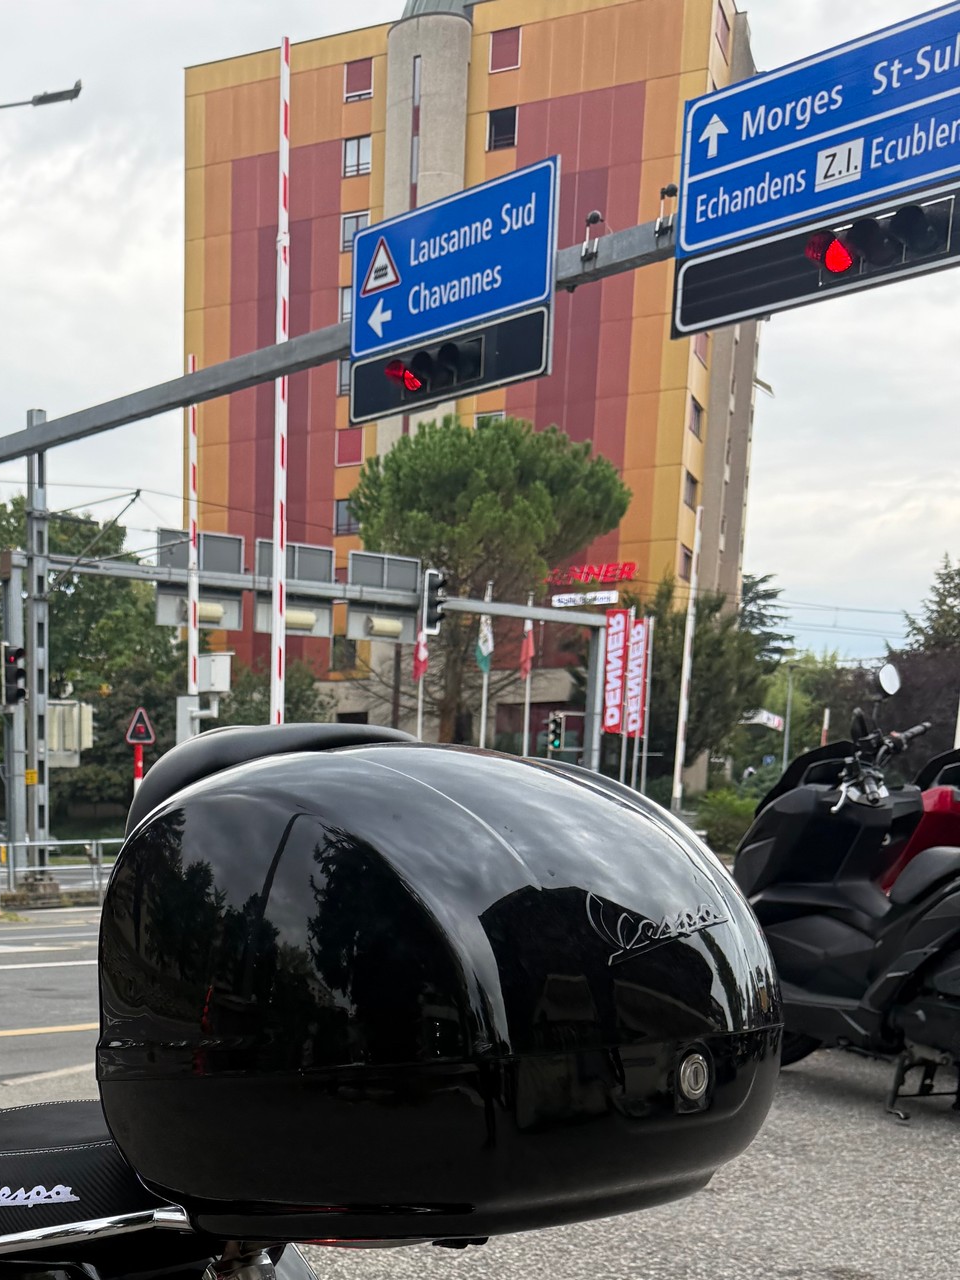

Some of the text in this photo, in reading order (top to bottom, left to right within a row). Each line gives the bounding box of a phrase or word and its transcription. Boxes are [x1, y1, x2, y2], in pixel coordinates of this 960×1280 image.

[741, 32, 960, 141] Morges St-Sul
[696, 168, 806, 224] Echandens
[823, 147, 858, 181] Z.I.
[410, 192, 536, 267] Lausanne Sud
[408, 265, 502, 315] Chavannes
[586, 891, 729, 966] Vespa
